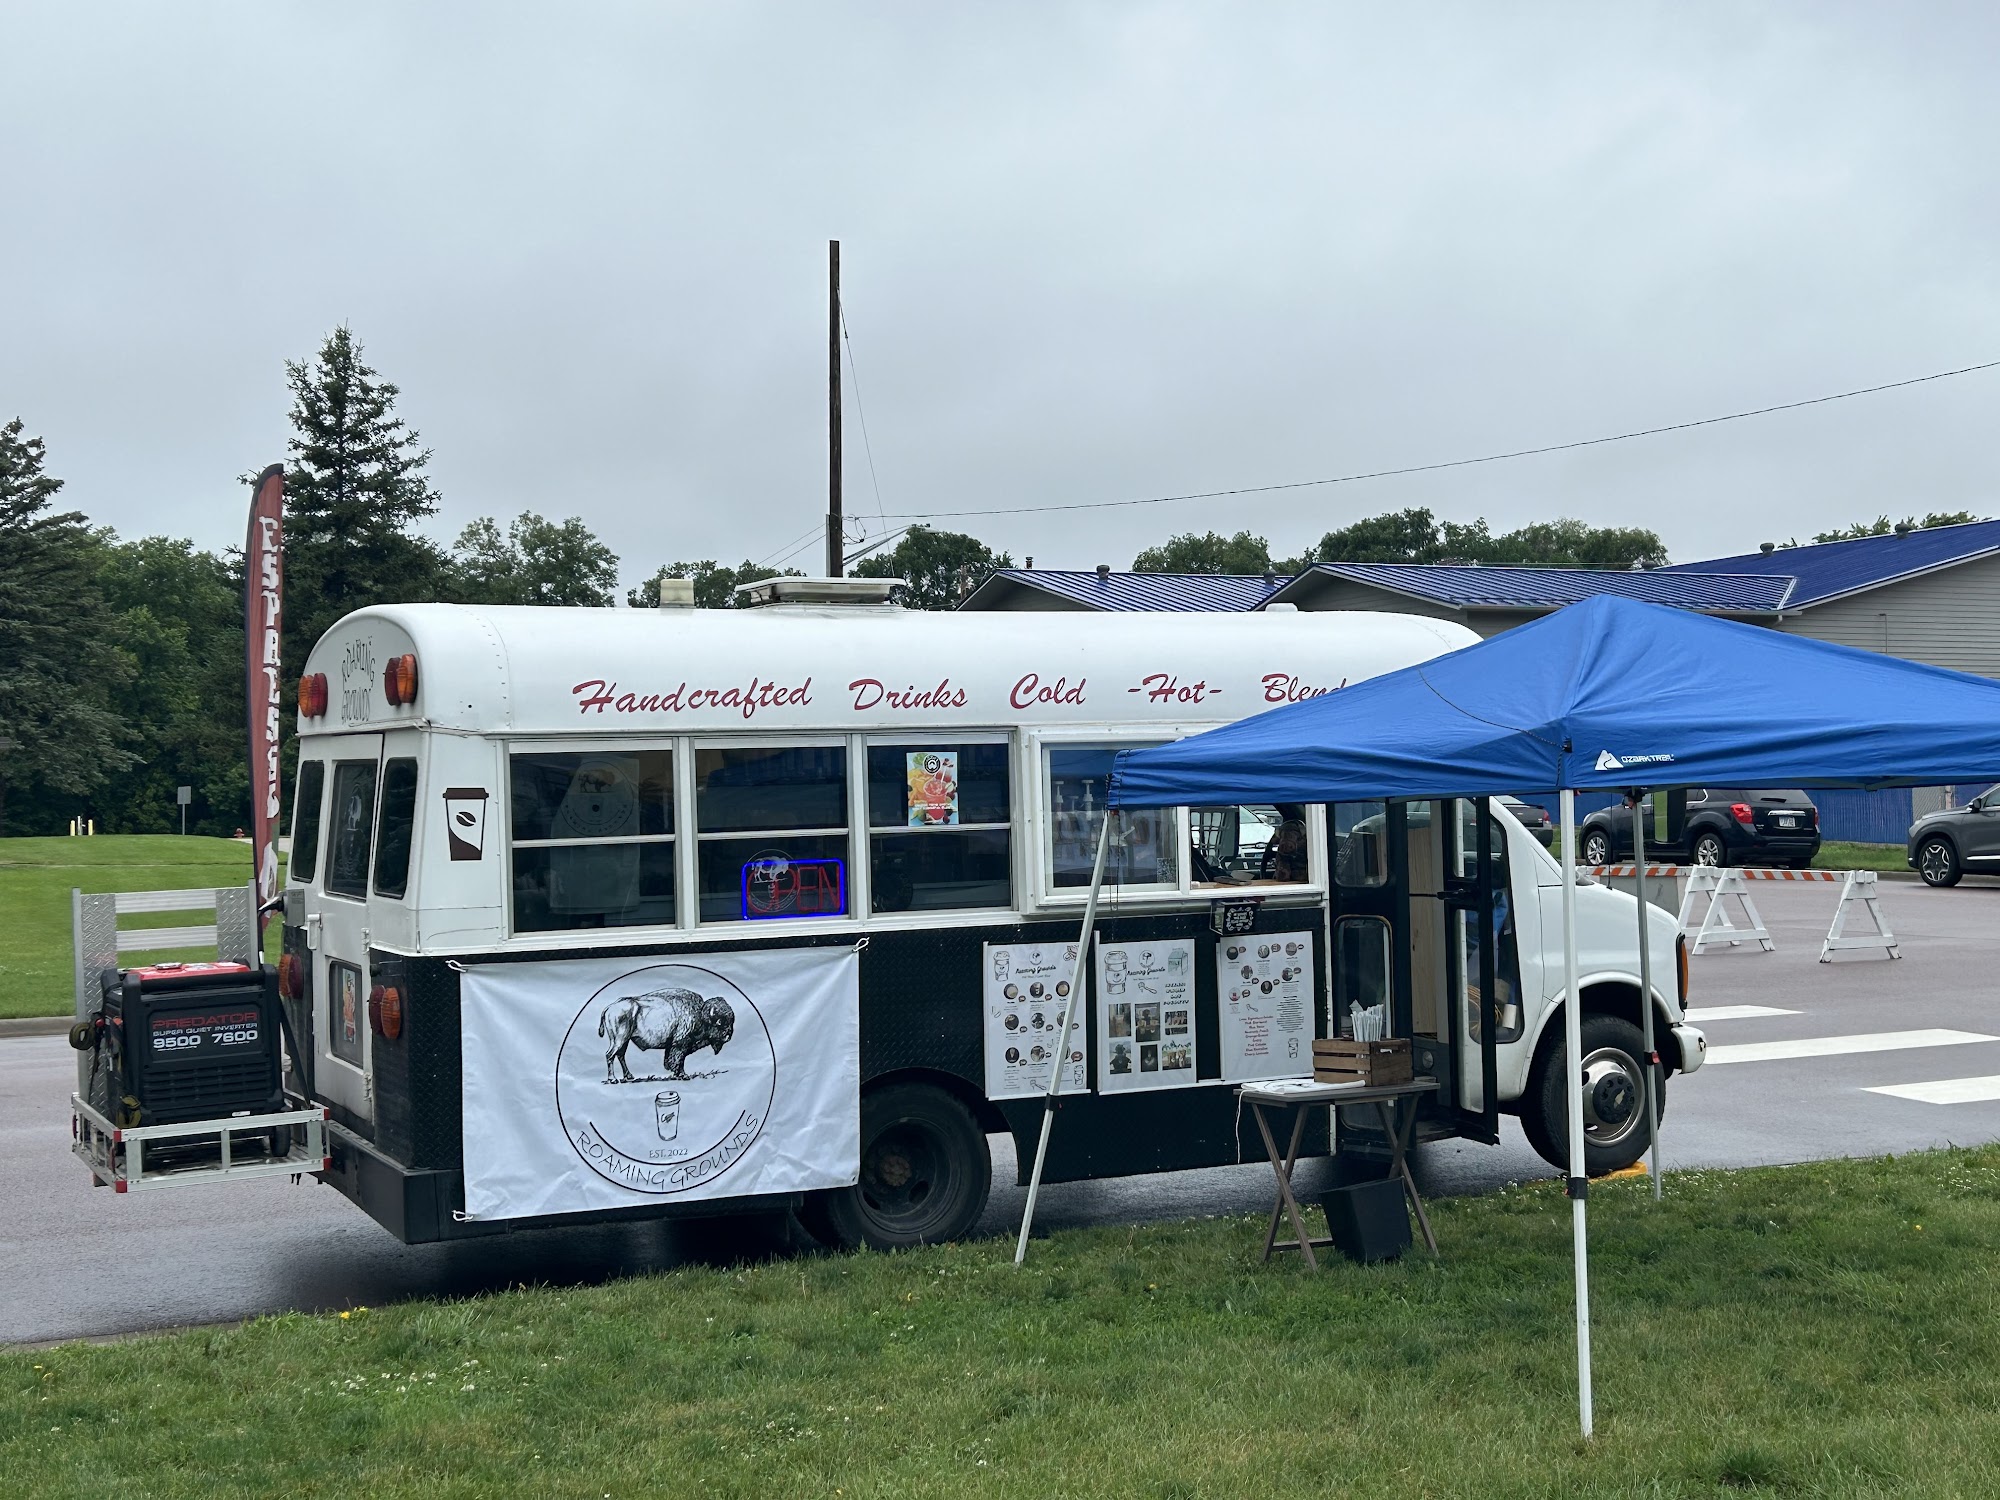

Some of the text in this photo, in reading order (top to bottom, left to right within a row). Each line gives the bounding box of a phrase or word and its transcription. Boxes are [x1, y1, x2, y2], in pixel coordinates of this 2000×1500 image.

[572, 676, 813, 719] Handcrafted
[848, 678, 969, 711] Drinks
[1010, 673, 1087, 709] Cold
[746, 864, 841, 914] OPEN
[152, 1012, 257, 1030] PREDATOR
[153, 1022, 258, 1037] SUPER QUIET INVERTER
[153, 1034, 202, 1049] 9500
[211, 1029, 258, 1043] 7600
[577, 1114, 759, 1190] ROAMING GROUNDS
